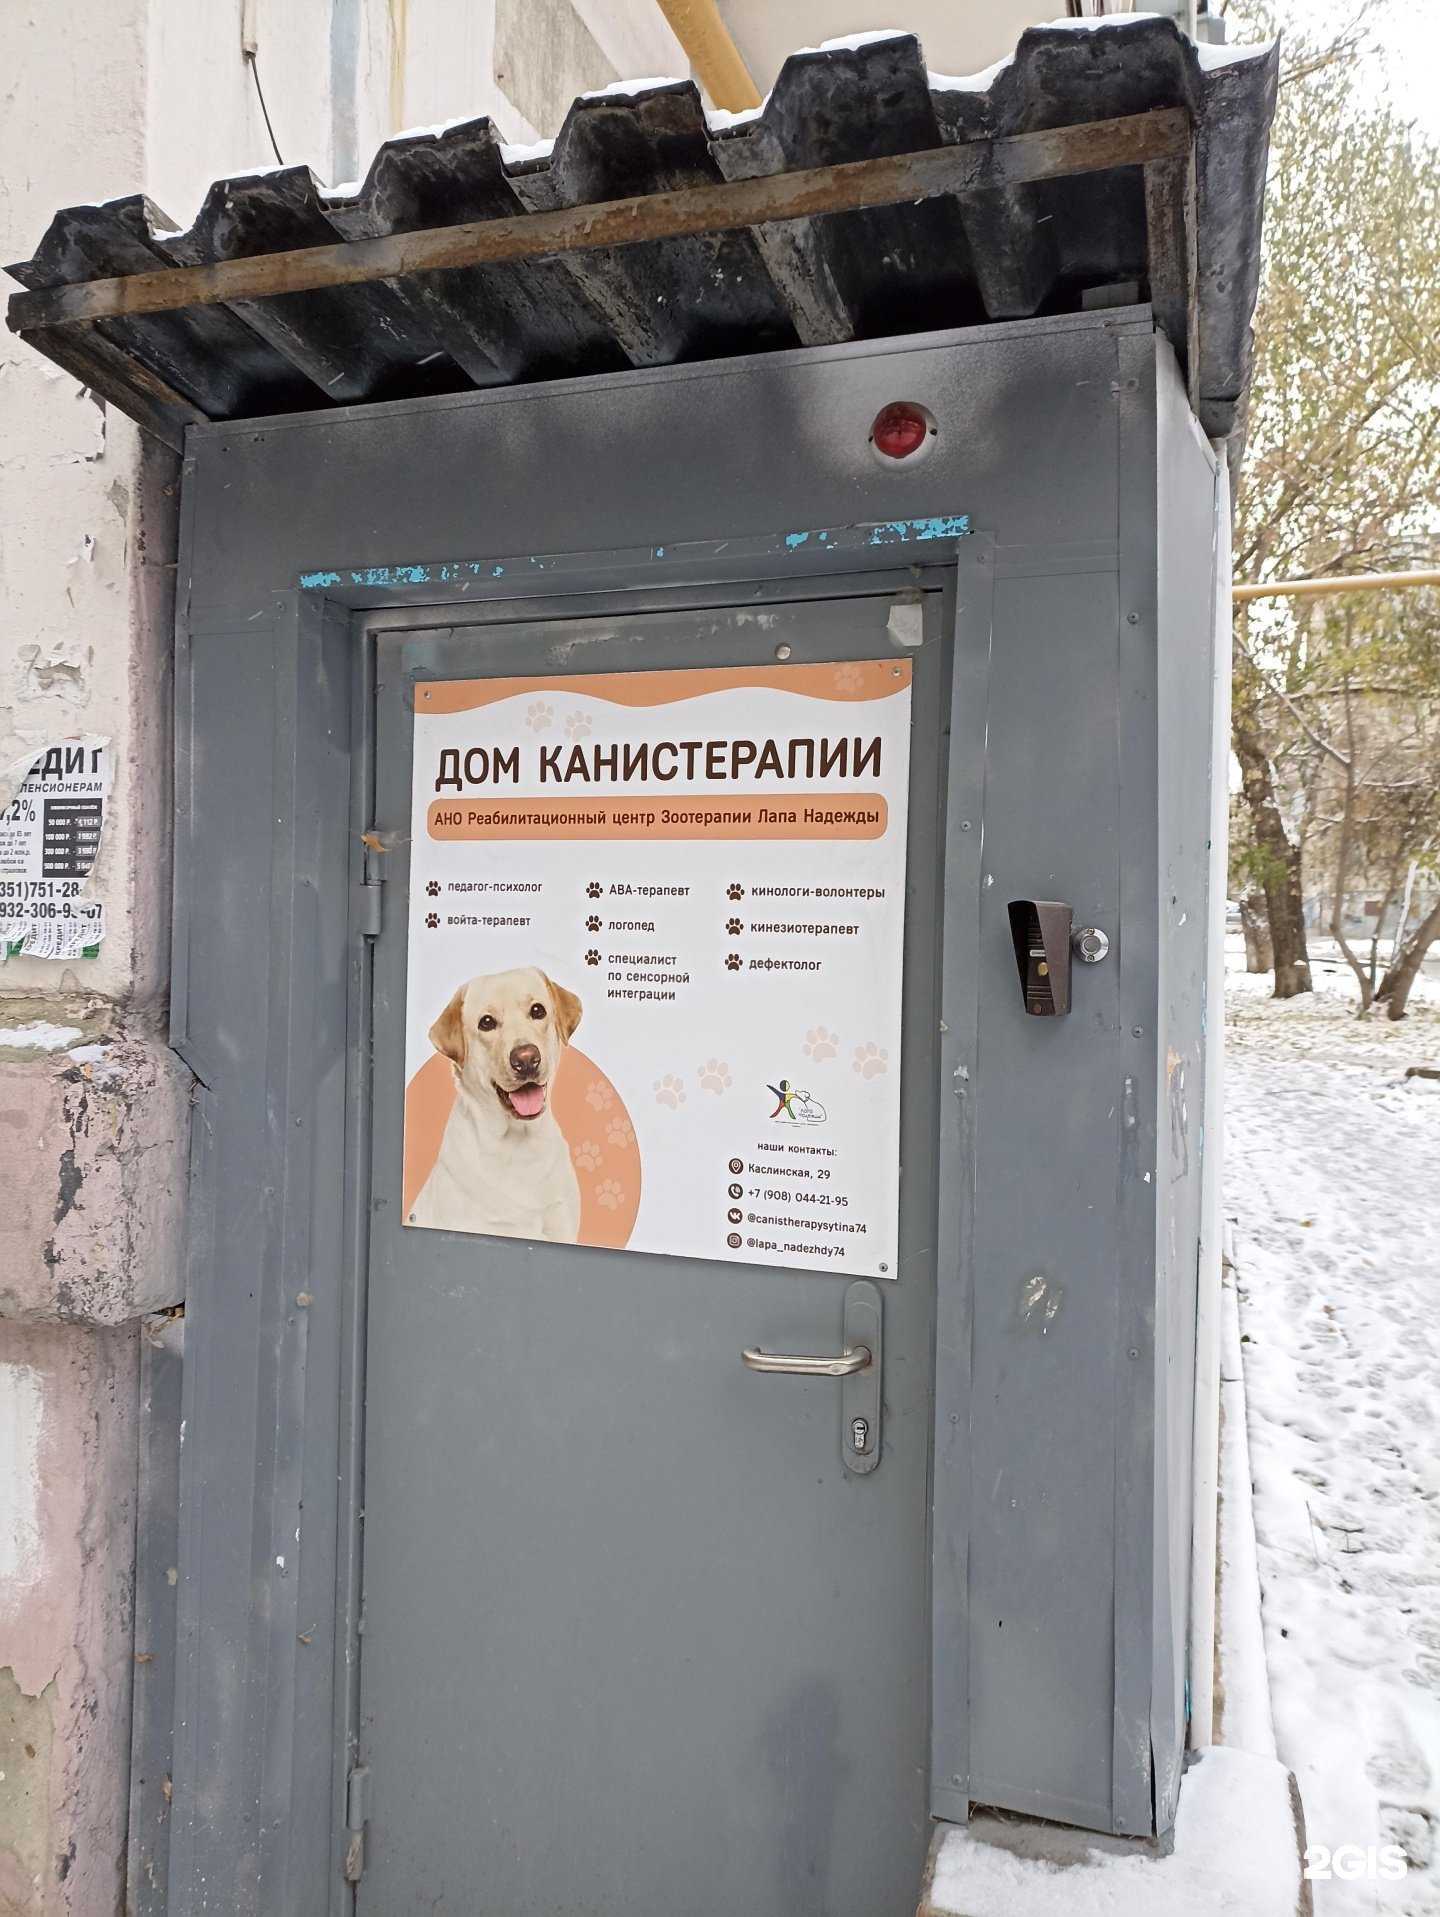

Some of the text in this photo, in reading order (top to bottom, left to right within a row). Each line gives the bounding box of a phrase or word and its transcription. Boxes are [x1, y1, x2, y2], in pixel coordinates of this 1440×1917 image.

[435, 736, 882, 792] ДОМ КАНИСТЕРАПИИ
[434, 808, 879, 831] АНО Реабилитационный центр Зоотерапии Лапа Надежды
[447, 881, 542, 894] педагог-психолог
[609, 884, 690, 898] АВА-терапевт
[751, 886, 885, 900] кинологи-волонтеры
[447, 914, 532, 928] войта-терапевт
[608, 920, 655, 932] логопед
[750, 922, 859, 936] кинезиотерапевт
[608, 953, 677, 967] специалист
[749, 957, 822, 971] дефектолог
[607, 971, 690, 985] по сенсорной
[607, 988, 676, 1002] интеграции
[757, 1143, 838, 1157] наши контакты:
[748, 1163, 831, 1180] Каслинская, 29
[748, 1188, 849, 1207] +7 (908) 044-21-95
[747, 1212, 867, 1234] @canistherapysytina74
[746, 1237, 845, 1258] @lapa_nadezhdy74
